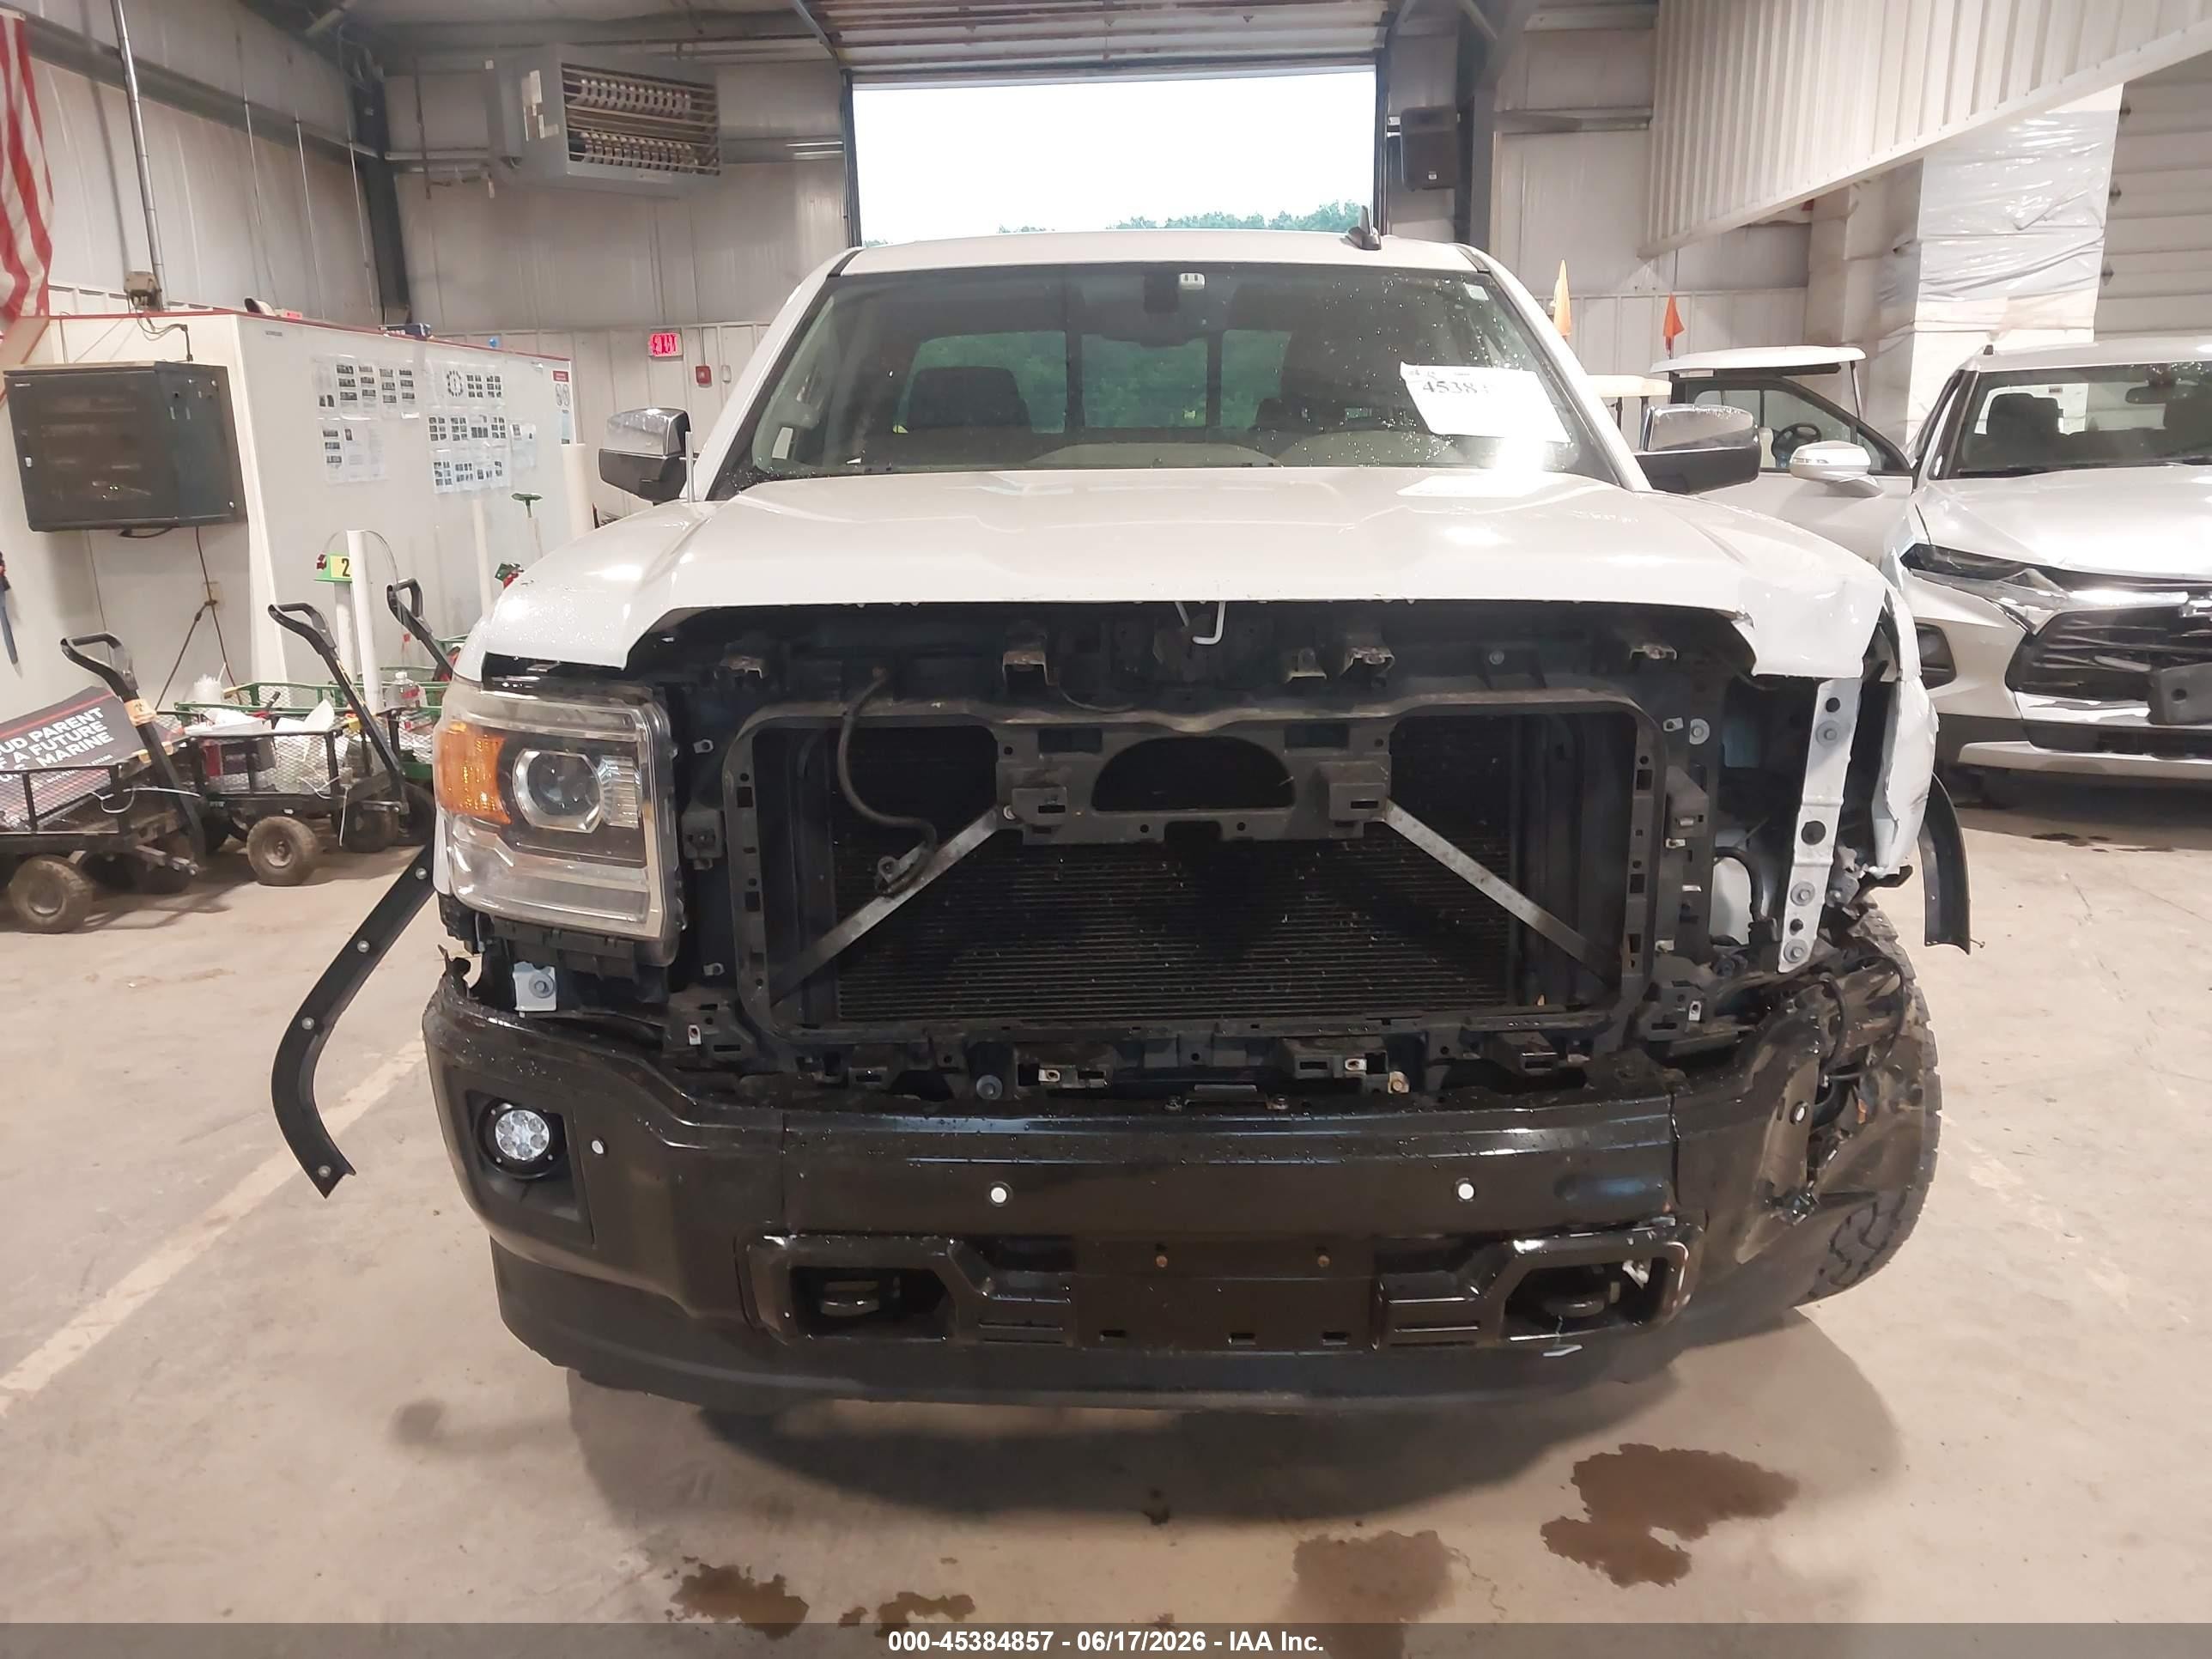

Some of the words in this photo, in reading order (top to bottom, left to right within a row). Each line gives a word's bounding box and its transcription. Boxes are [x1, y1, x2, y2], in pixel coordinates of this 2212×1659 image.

[341, 557, 351, 577] 2
[13, 750, 31, 764] A
[28, 720, 108, 757] FUTURE
[27, 707, 104, 743] PARENT
[35, 732, 115, 767] MARINE
